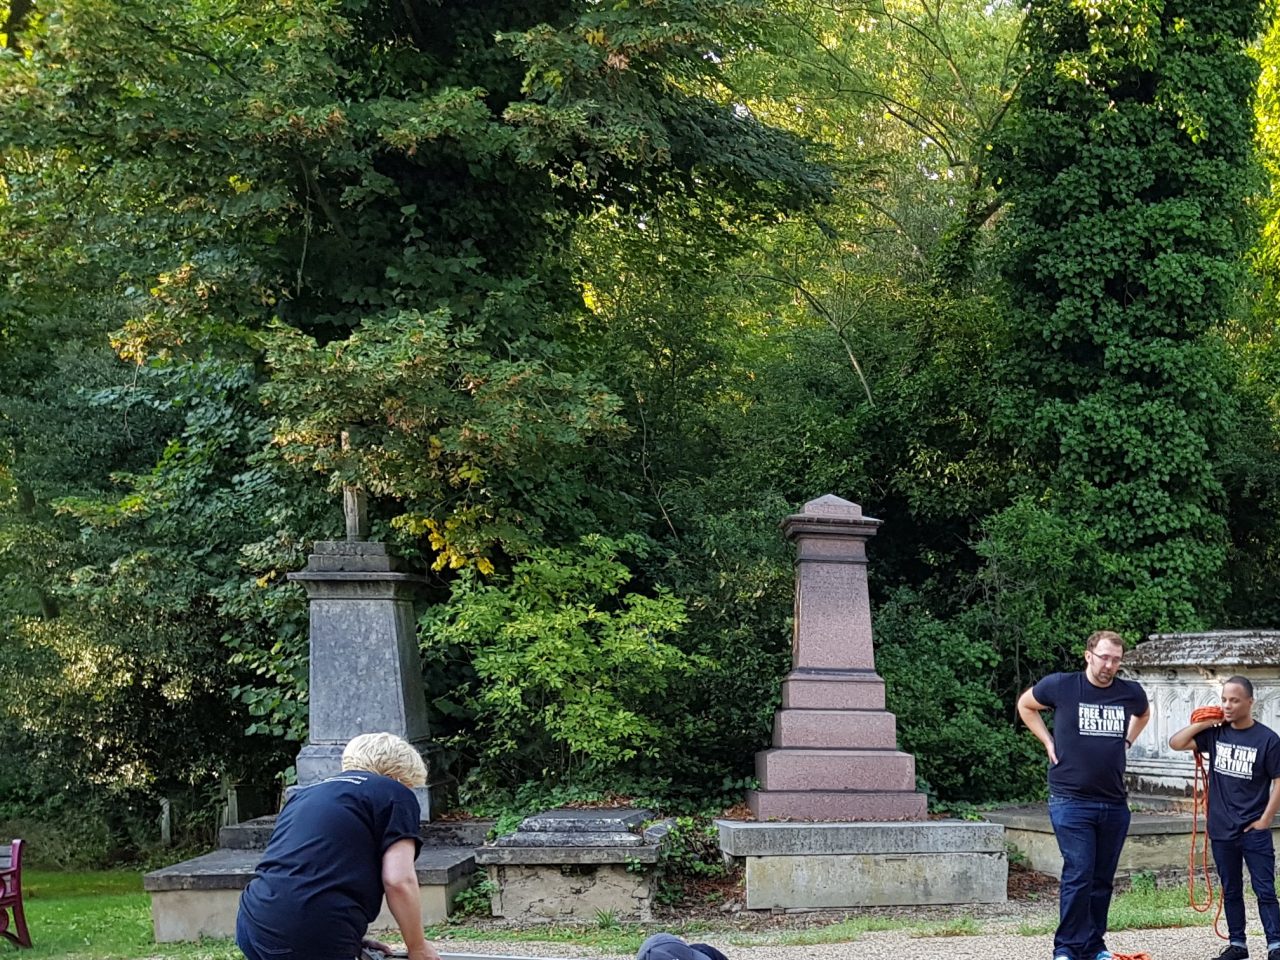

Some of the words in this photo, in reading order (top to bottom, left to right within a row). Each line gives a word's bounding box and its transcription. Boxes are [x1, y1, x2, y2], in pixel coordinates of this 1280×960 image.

[1079, 707, 1100, 719] FREE
[1103, 709, 1125, 720] FILM
[1078, 717, 1124, 731] FESTIVAL
[1234, 748, 1257, 763] FILM
